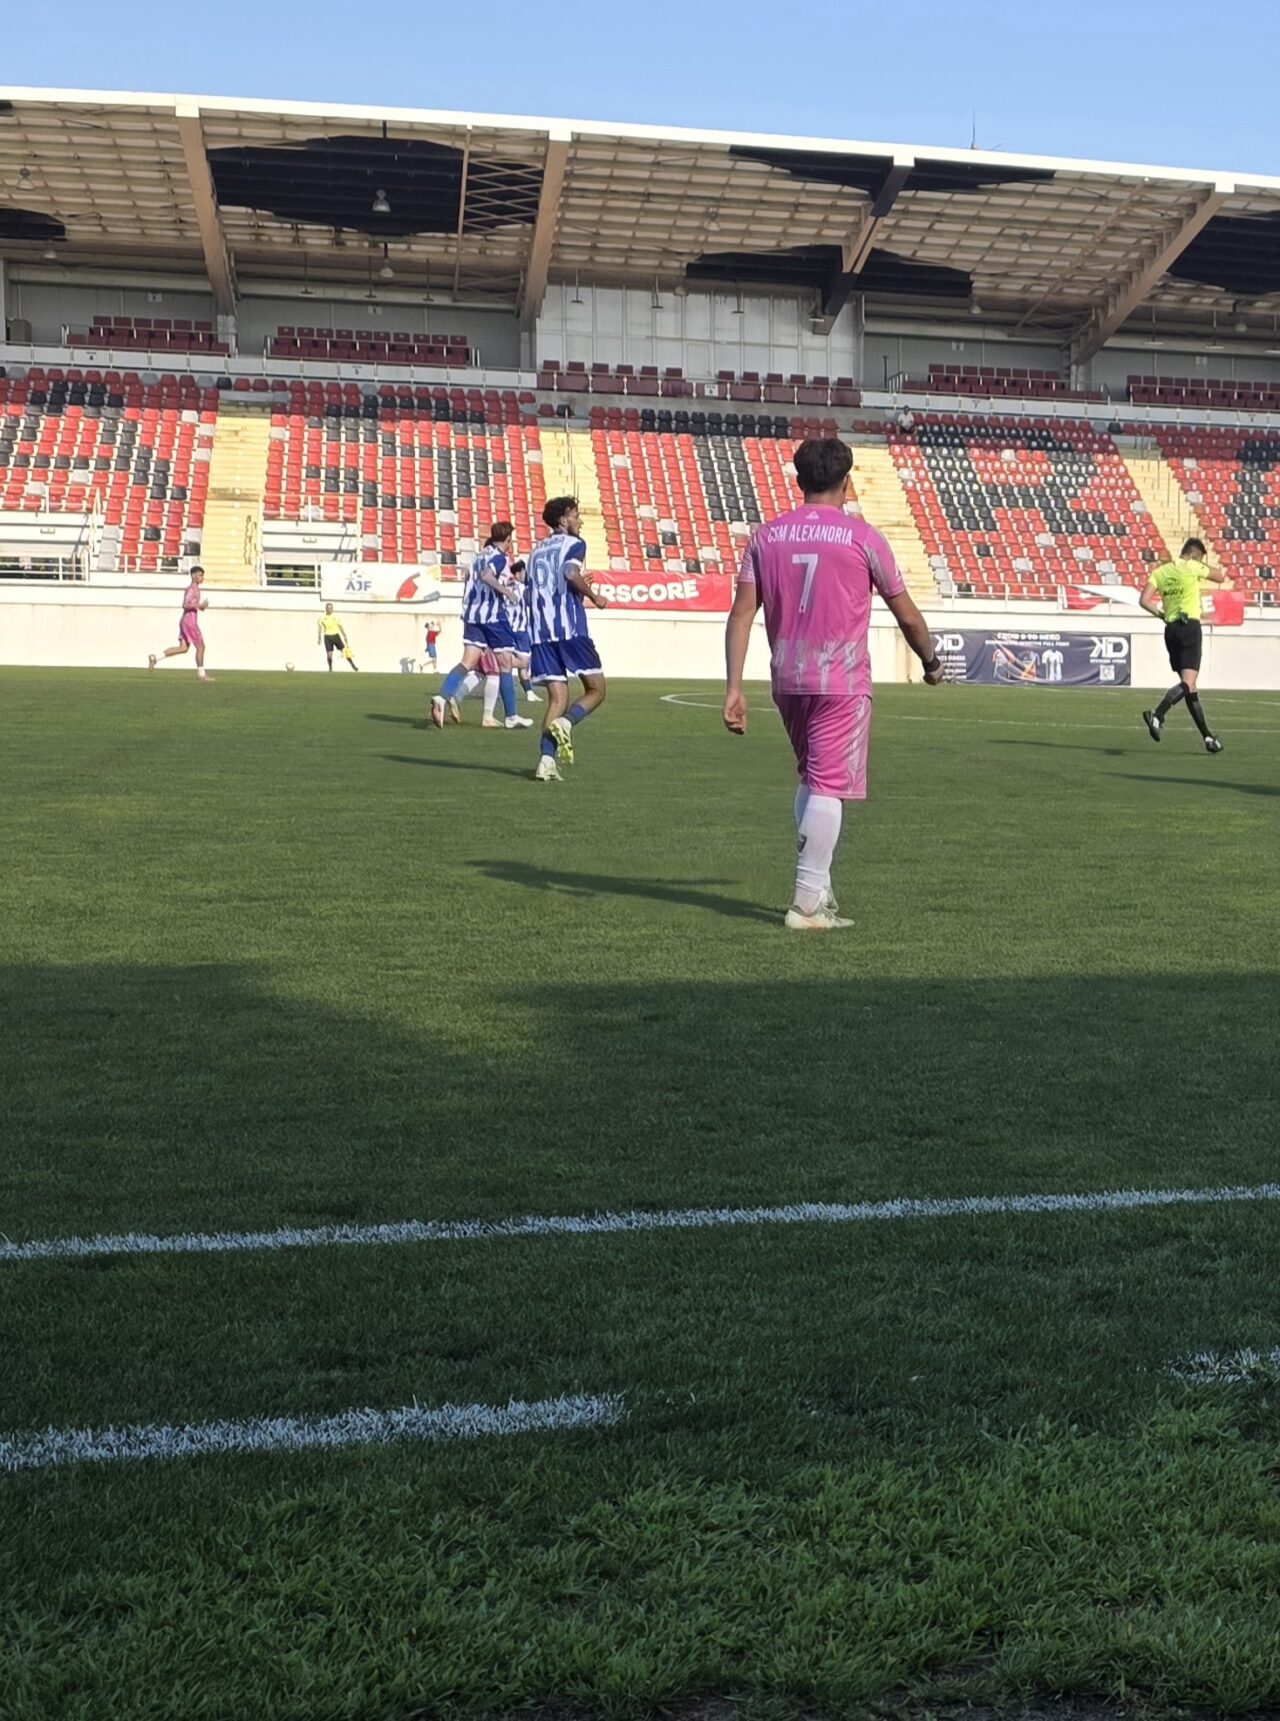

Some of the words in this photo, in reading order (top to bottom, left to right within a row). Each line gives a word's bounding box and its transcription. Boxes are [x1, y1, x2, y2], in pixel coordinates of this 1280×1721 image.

[767, 524, 787, 543] CSM
[788, 524, 854, 546] ALEXANDRIA
[346, 580, 372, 592] AJF
[792, 553, 819, 614] 7
